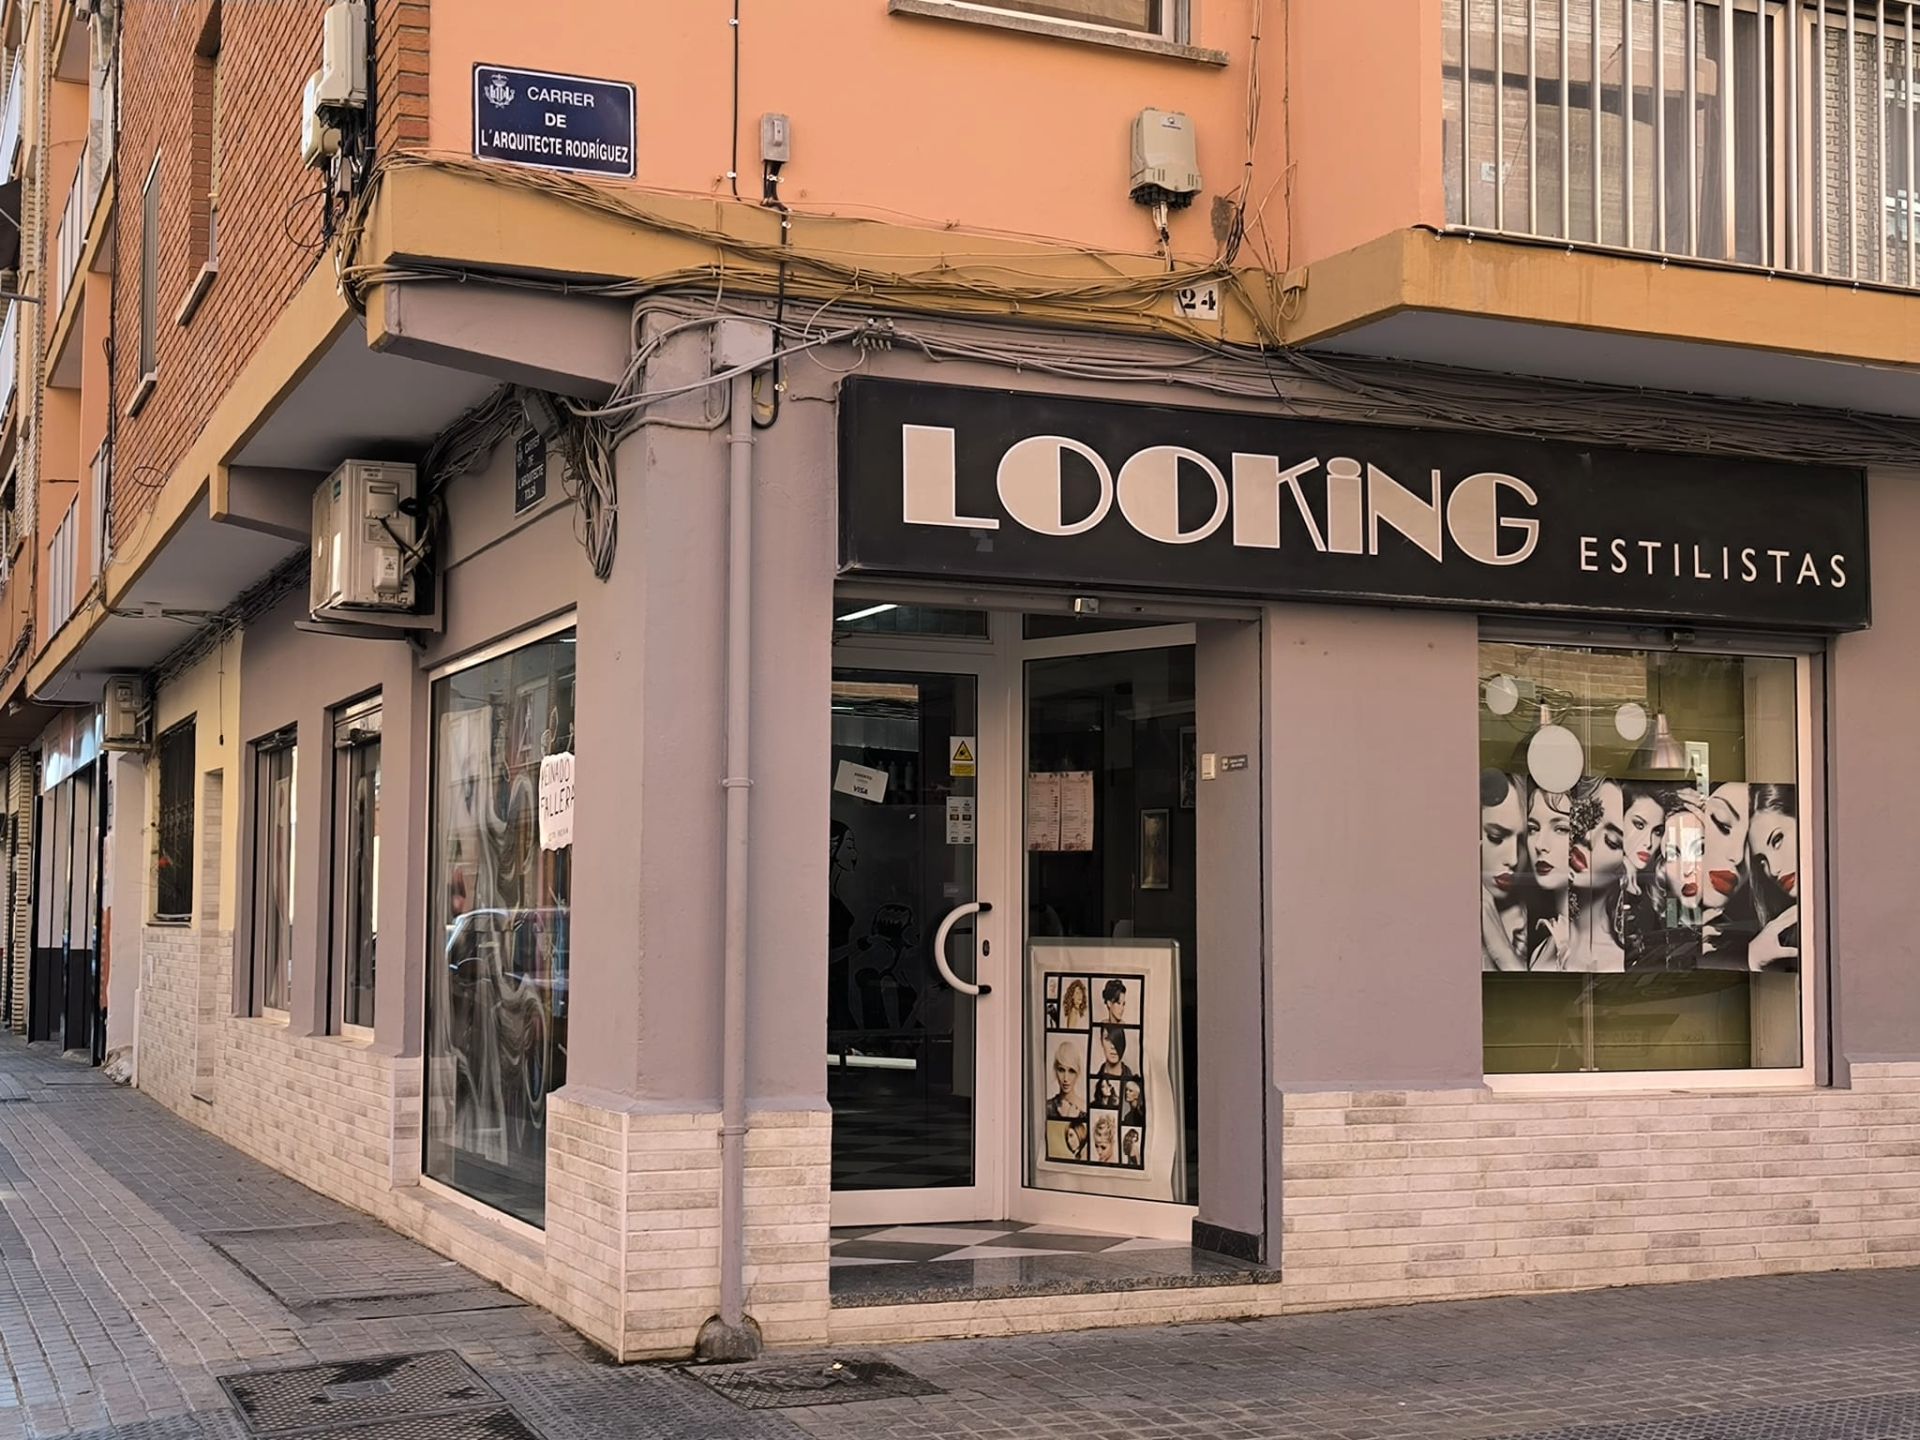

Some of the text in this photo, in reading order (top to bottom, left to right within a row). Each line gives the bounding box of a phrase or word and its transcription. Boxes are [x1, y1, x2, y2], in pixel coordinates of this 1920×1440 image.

[527, 86, 595, 108] CARRER
[544, 113, 568, 128] DE
[565, 137, 629, 164] RODRÍGUEZ
[1181, 288, 1216, 311] 24
[1579, 535, 1847, 589] ESTILISTAS
[853, 785, 869, 795] VISA
